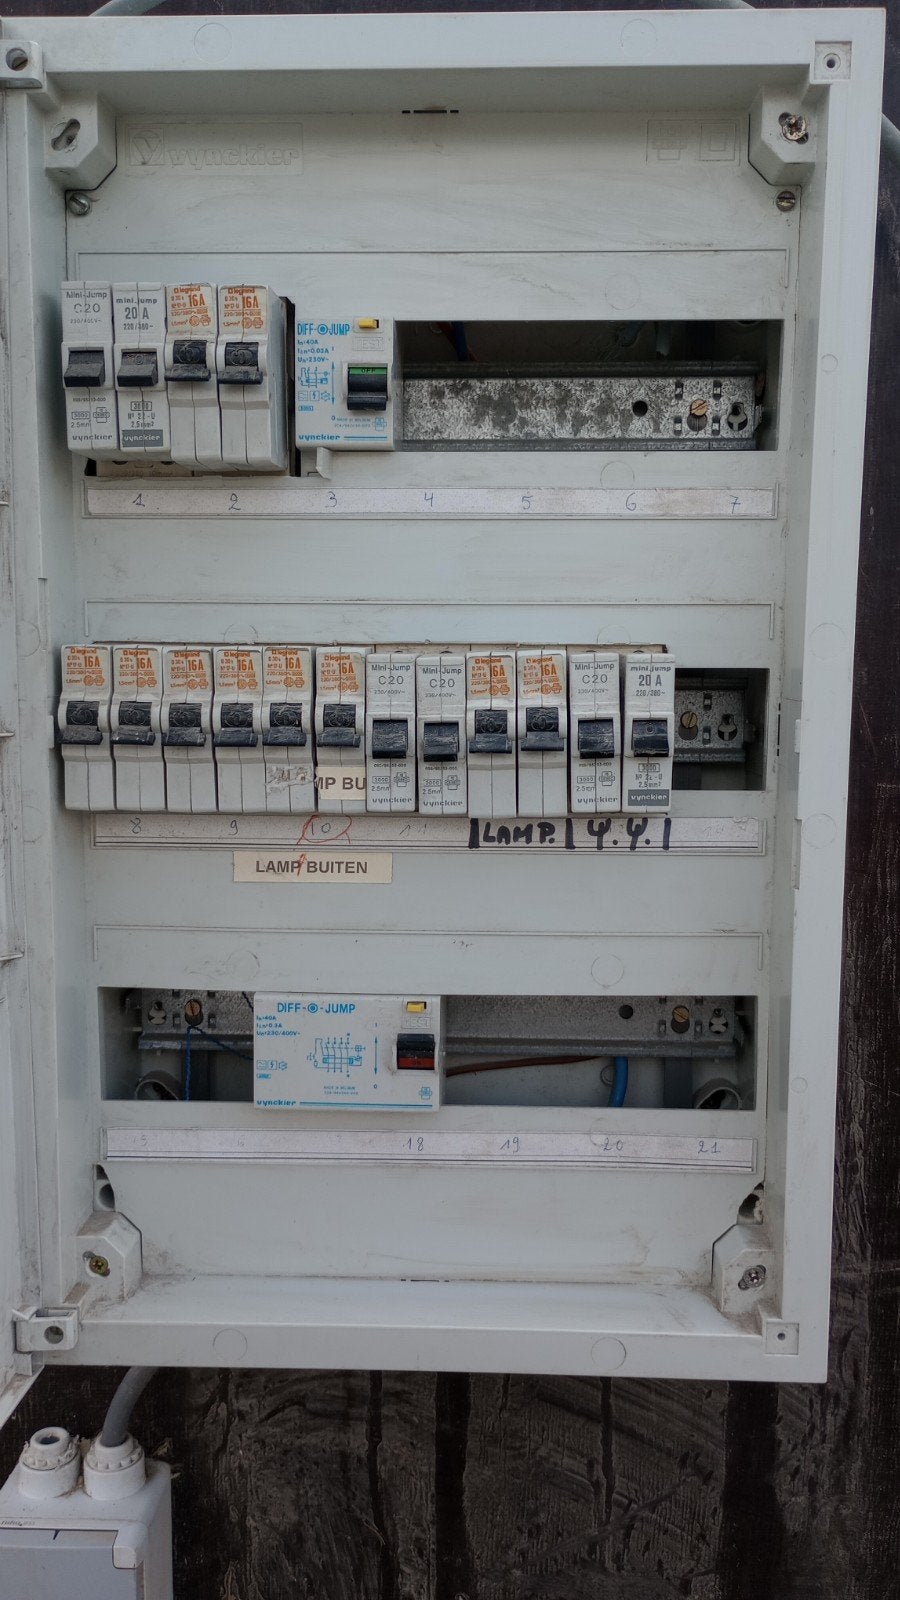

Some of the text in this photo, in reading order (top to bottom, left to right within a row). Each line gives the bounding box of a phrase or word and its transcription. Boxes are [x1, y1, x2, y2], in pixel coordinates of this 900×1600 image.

[167, 144, 299, 170] vynckier
[66, 291, 108, 299] Mini-Jump
[188, 294, 206, 307] 16A
[73, 303, 101, 313] C20
[242, 296, 259, 308] 16A
[124, 307, 150, 319] 20 A
[72, 434, 113, 442] vynckier
[123, 434, 161, 442] vynckier
[298, 434, 340, 442] vynckier
[132, 491, 741, 514] 1 2 3 4 5 6 7
[84, 656, 100, 667] 16A
[188, 659, 204, 671] 16A
[238, 659, 254, 671] 16A
[371, 664, 411, 672] Mini-Jump
[378, 675, 404, 685] C20
[429, 678, 455, 688] C20
[582, 674, 608, 683] C20
[638, 674, 662, 686] 20 A
[342, 777, 367, 789] BU
[130, 817, 141, 834] 8
[228, 820, 238, 835] 9
[312, 821, 332, 836] 10
[483, 821, 555, 845] LAMP.
[255, 860, 368, 874] LAMP BUITEN
[256, 1099, 297, 1107] vynckier
[403, 1136, 424, 1152] 18
[500, 1136, 519, 1154] 19
[603, 1137, 623, 1151] 20
[697, 1140, 721, 1154] 21
